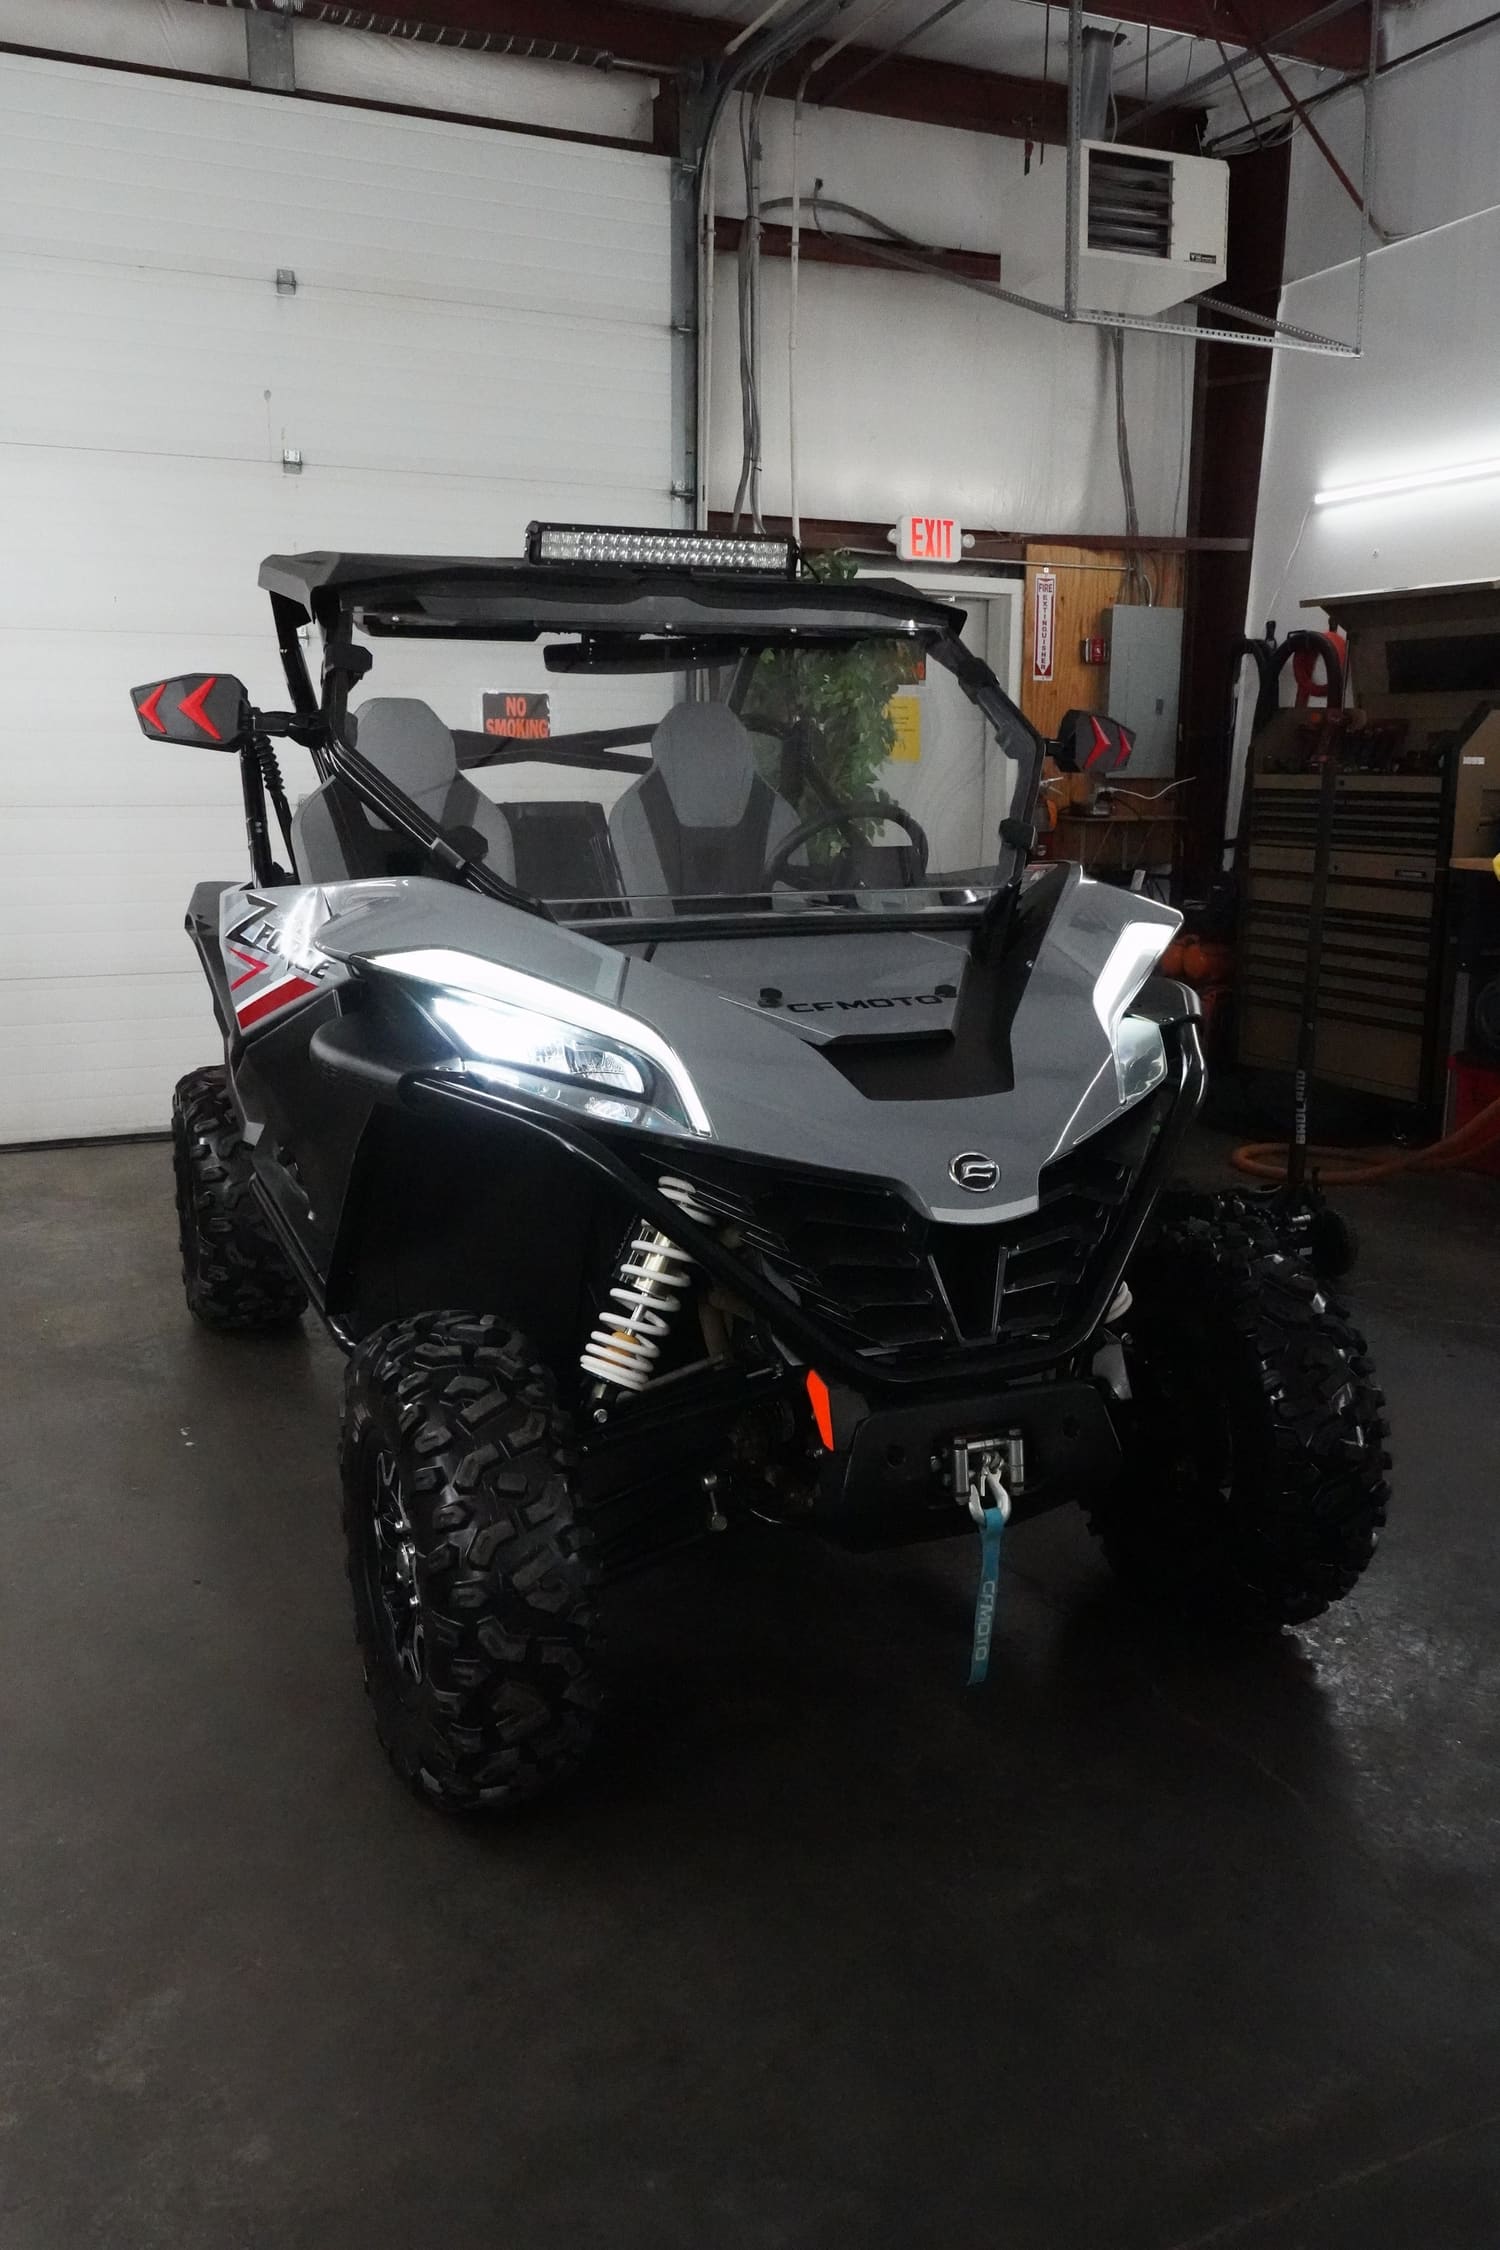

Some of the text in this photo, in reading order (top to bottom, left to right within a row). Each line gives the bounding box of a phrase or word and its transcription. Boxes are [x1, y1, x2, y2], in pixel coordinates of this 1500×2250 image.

[912, 517, 954, 559] EXIT
[1038, 583, 1053, 593] FIRE
[1041, 594, 1049, 671] EXTINGUISHER
[505, 696, 527, 717] NO
[485, 718, 549, 739] SMOKING
[786, 995, 944, 1014] CFMOTO
[975, 1580, 996, 1662] CFMOTO
